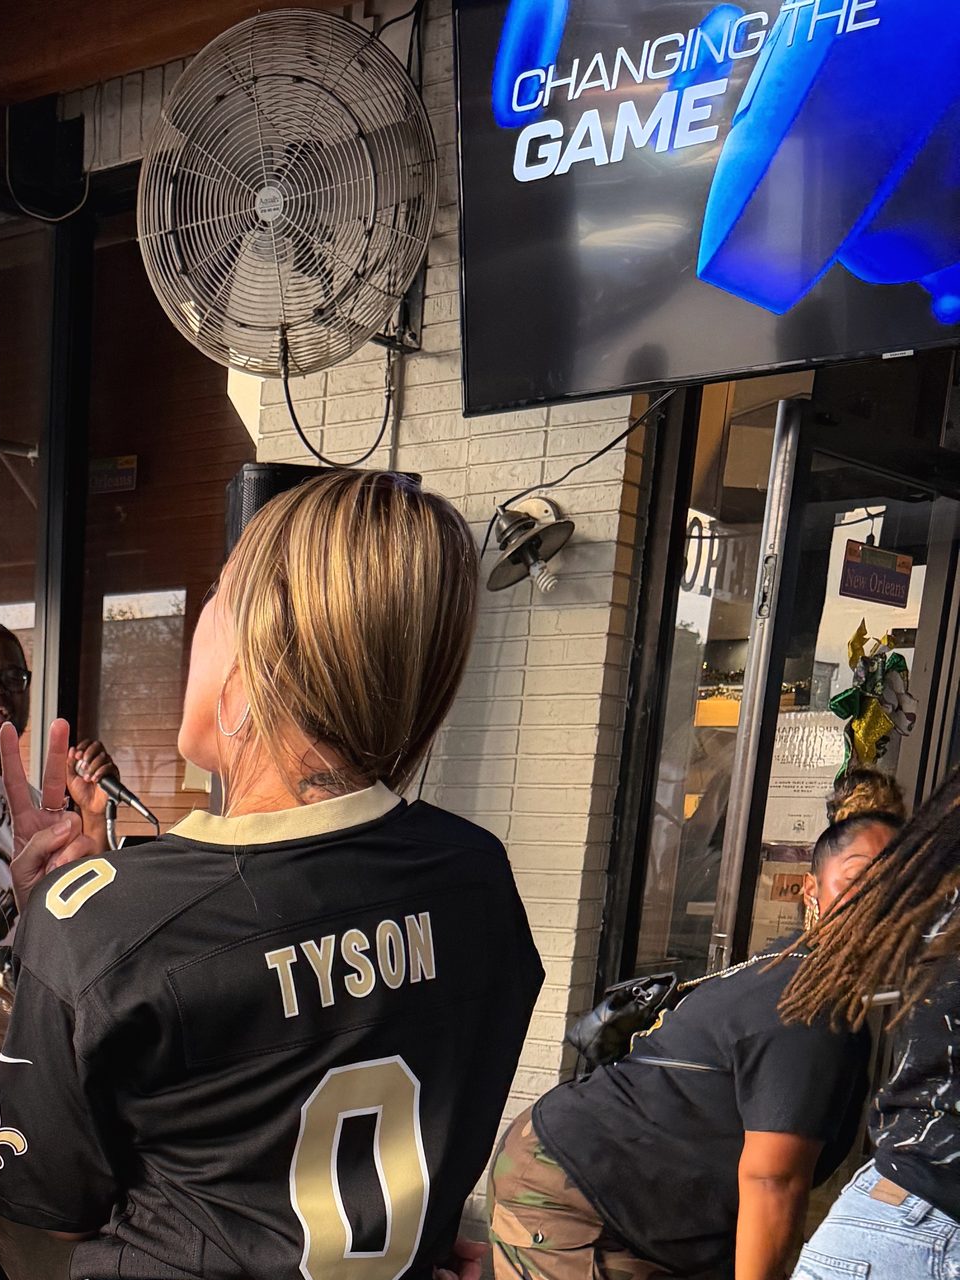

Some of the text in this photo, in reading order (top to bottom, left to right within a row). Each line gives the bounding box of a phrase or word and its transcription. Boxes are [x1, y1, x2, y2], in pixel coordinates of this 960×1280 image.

[512, 0, 881, 113] CHANGING THE
[513, 78, 729, 182] GAME
[844, 568, 906, 599] New Orleans
[45, 857, 118, 920] 0
[264, 911, 436, 1019] TYSON
